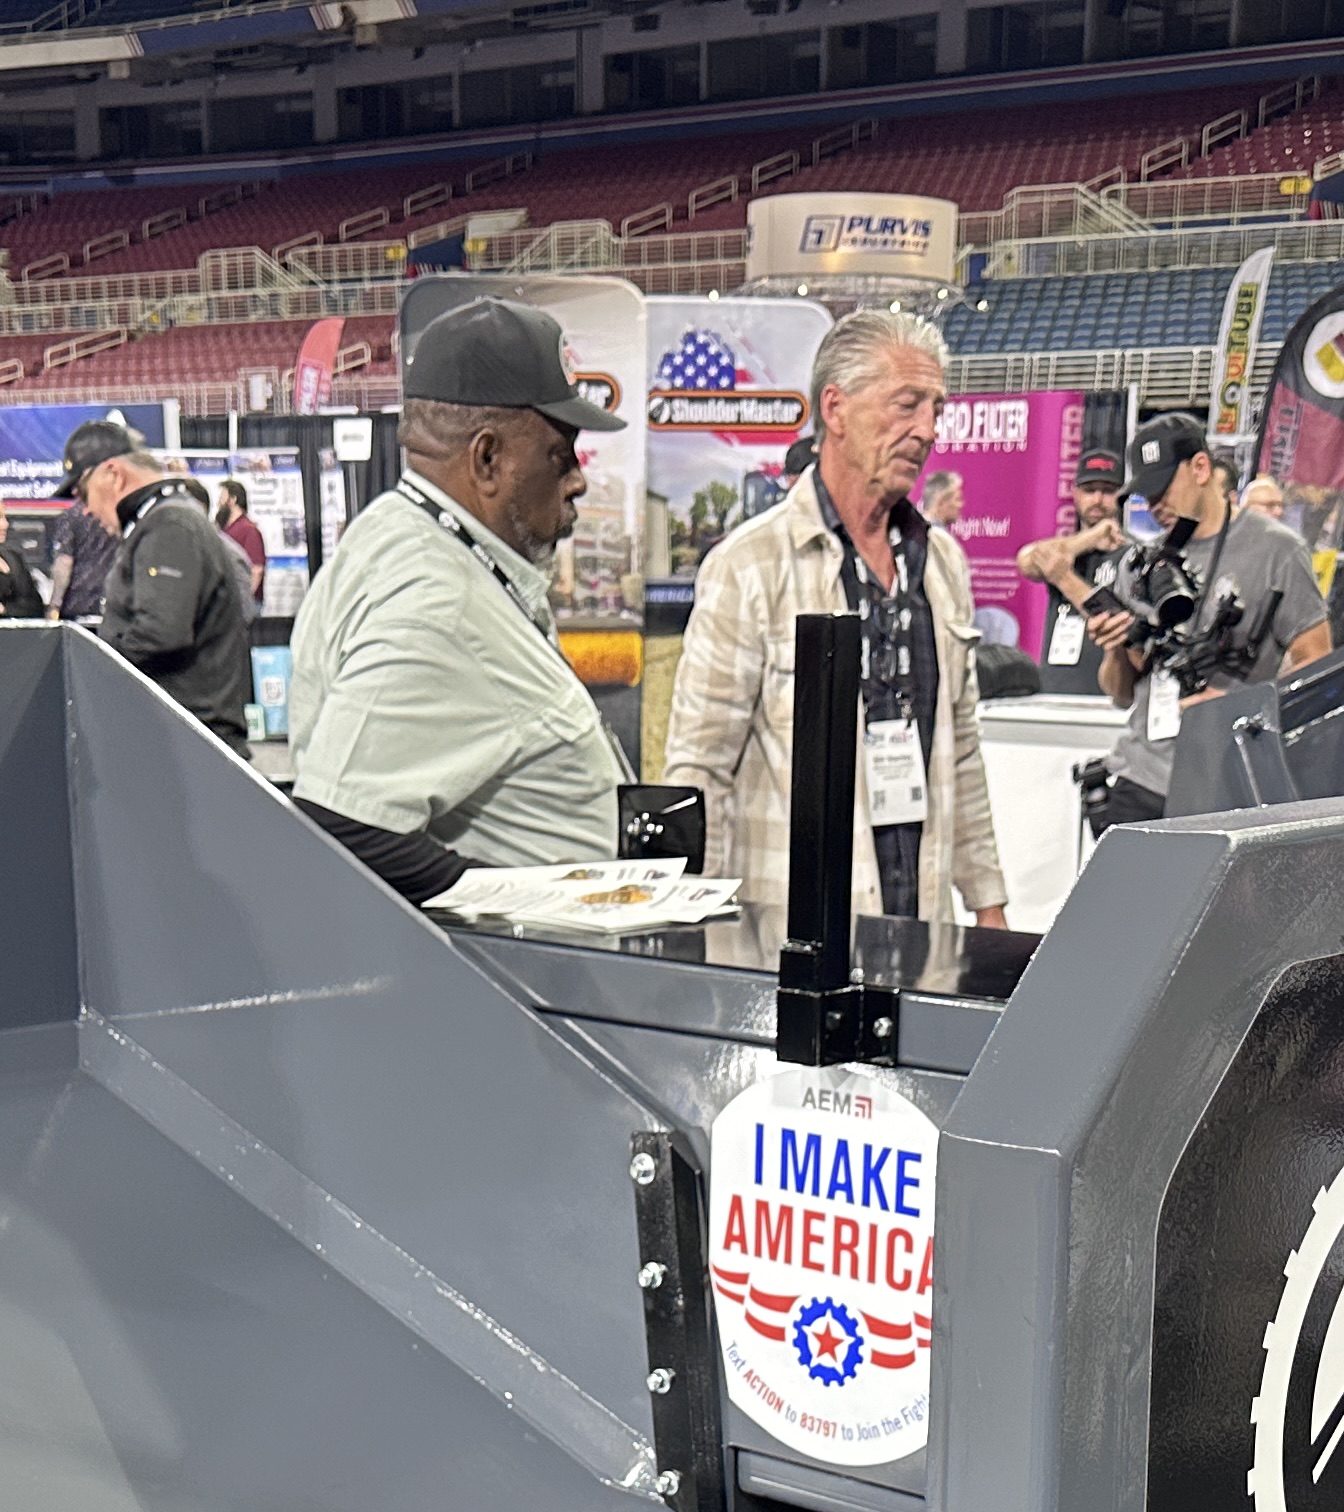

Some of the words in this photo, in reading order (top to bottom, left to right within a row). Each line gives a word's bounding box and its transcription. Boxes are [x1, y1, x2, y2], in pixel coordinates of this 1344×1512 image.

[846, 214, 933, 238] PURVIS
[671, 398, 802, 424] ShoulderMaster
[801, 1085, 852, 1115] AEM
[754, 1122, 764, 1185] I
[779, 1127, 922, 1218] MAKE
[725, 1341, 747, 1371] Text
[743, 1368, 785, 1414] ACTION
[785, 1404, 797, 1423] to
[800, 1413, 837, 1439] 83797
[841, 1424, 854, 1441] to
[857, 1422, 881, 1442] Join
[882, 1416, 903, 1436] the
